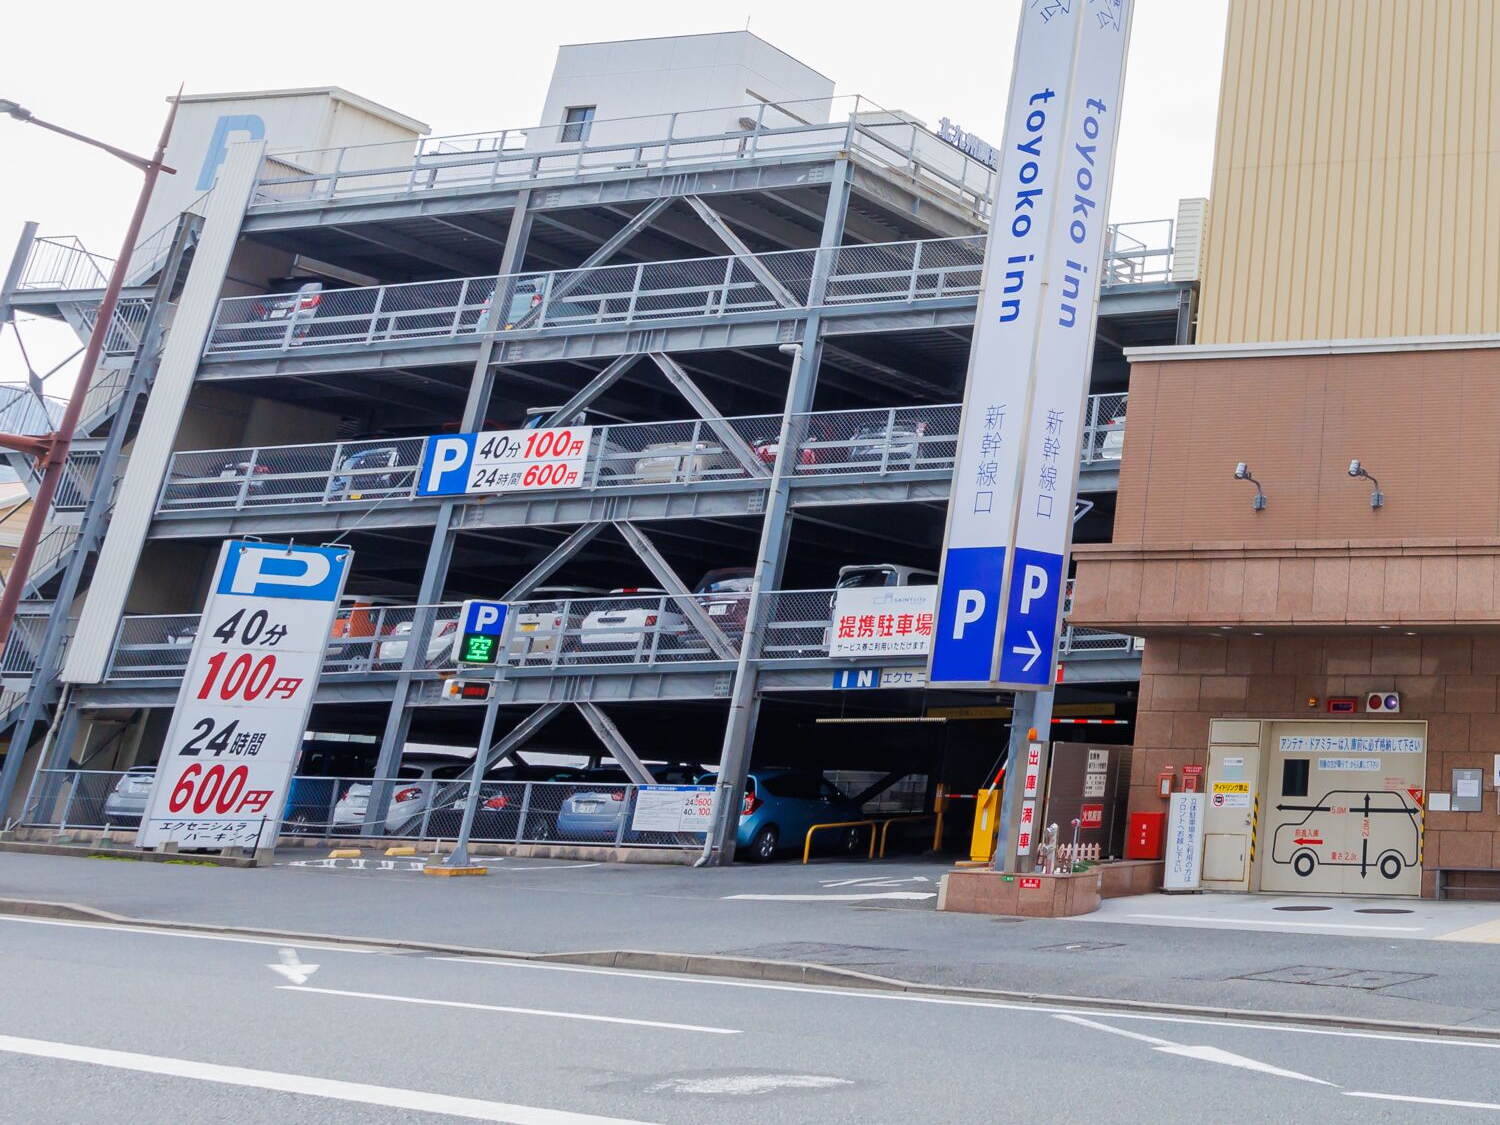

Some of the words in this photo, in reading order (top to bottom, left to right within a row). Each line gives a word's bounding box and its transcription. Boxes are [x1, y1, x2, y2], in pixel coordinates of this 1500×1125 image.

[1012, 88, 1055, 238] toyoko
[1069, 98, 1107, 244] toyoko
[999, 254, 1034, 323] inn
[1059, 260, 1088, 328] inn
[427, 438, 468, 492] P
[479, 436, 521, 459] 40分
[523, 430, 584, 459] 100円
[974, 404, 1007, 515] 新幹線口
[1037, 409, 1064, 519] 新幹線口
[472, 468, 522, 488] 24時間
[522, 463, 578, 487] 600円
[230, 547, 331, 594] P
[1020, 564, 1048, 614] P
[213, 608, 288, 646] 40分
[475, 605, 499, 632] P
[837, 613, 933, 638] 提携駐車場
[953, 589, 986, 639] P
[466, 636, 493, 661] 空
[197, 651, 304, 701] 100円
[841, 670, 873, 688] IN
[178, 717, 267, 757] 24時間
[169, 763, 274, 814] 600円
[1026, 750, 1039, 790] 出庫
[159, 822, 248, 832] エクセニシムラ
[1019, 807, 1033, 849] 満車
